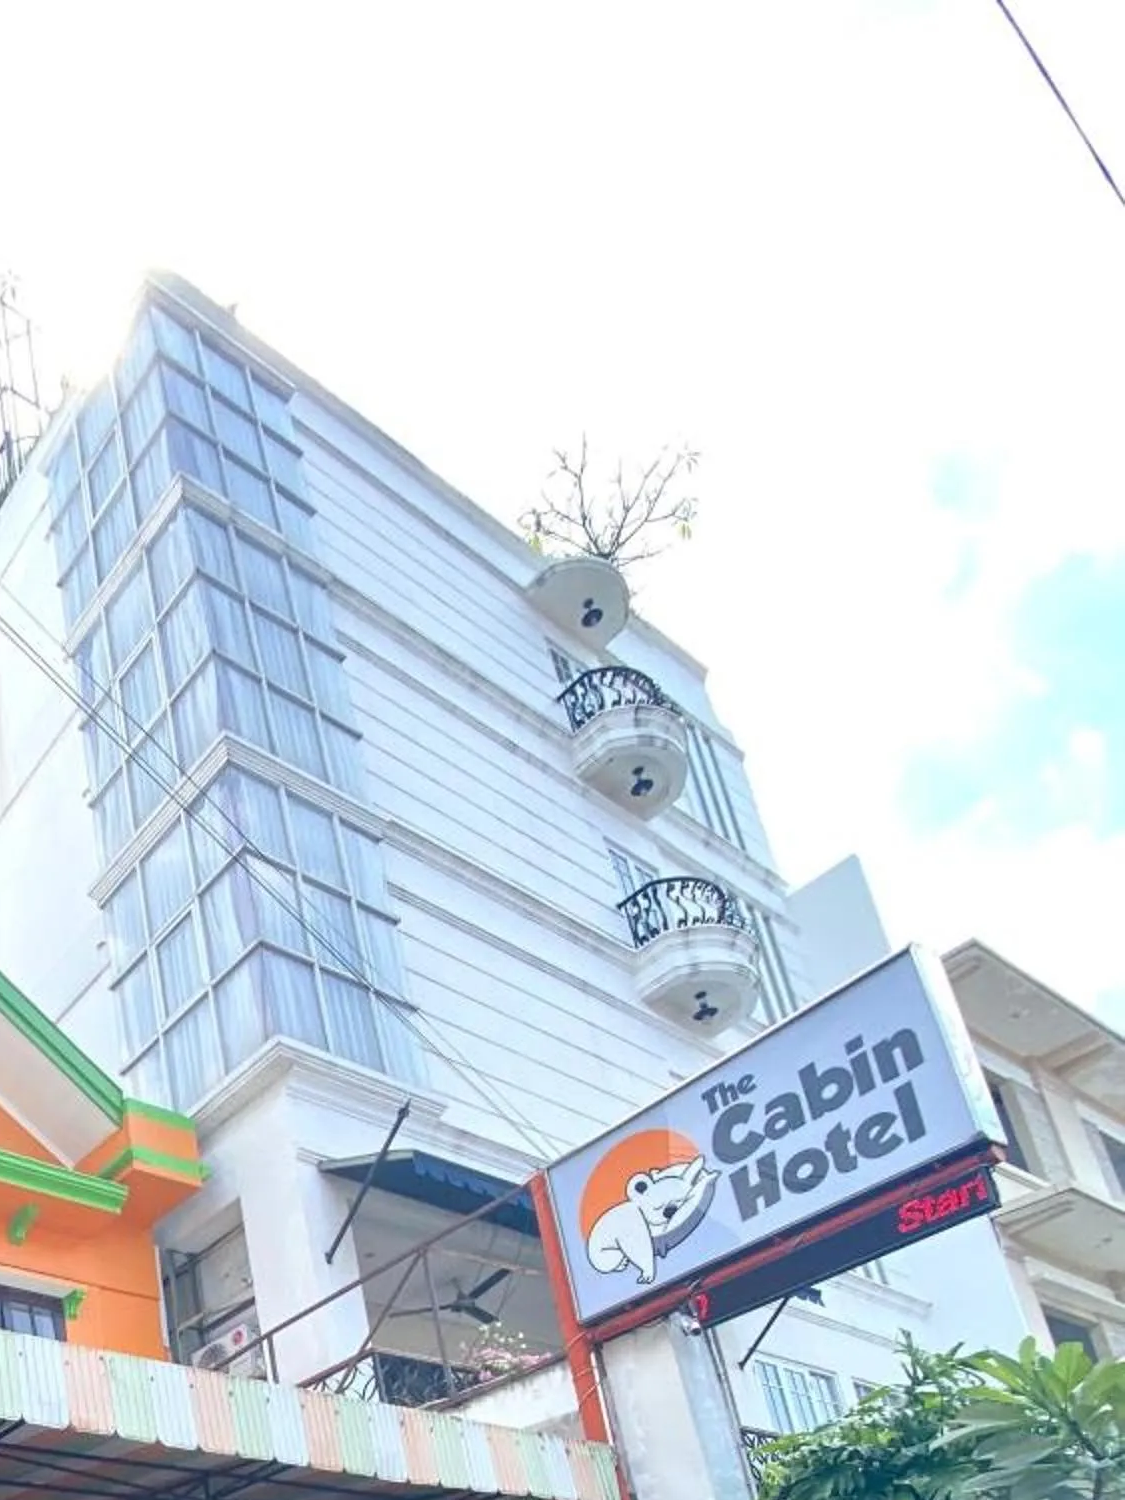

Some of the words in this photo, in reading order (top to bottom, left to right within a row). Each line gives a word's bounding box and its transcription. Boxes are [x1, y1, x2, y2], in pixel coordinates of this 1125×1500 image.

[700, 1074, 756, 1114] The
[712, 1028, 924, 1164] Cabin
[728, 1082, 926, 1222] Hotel
